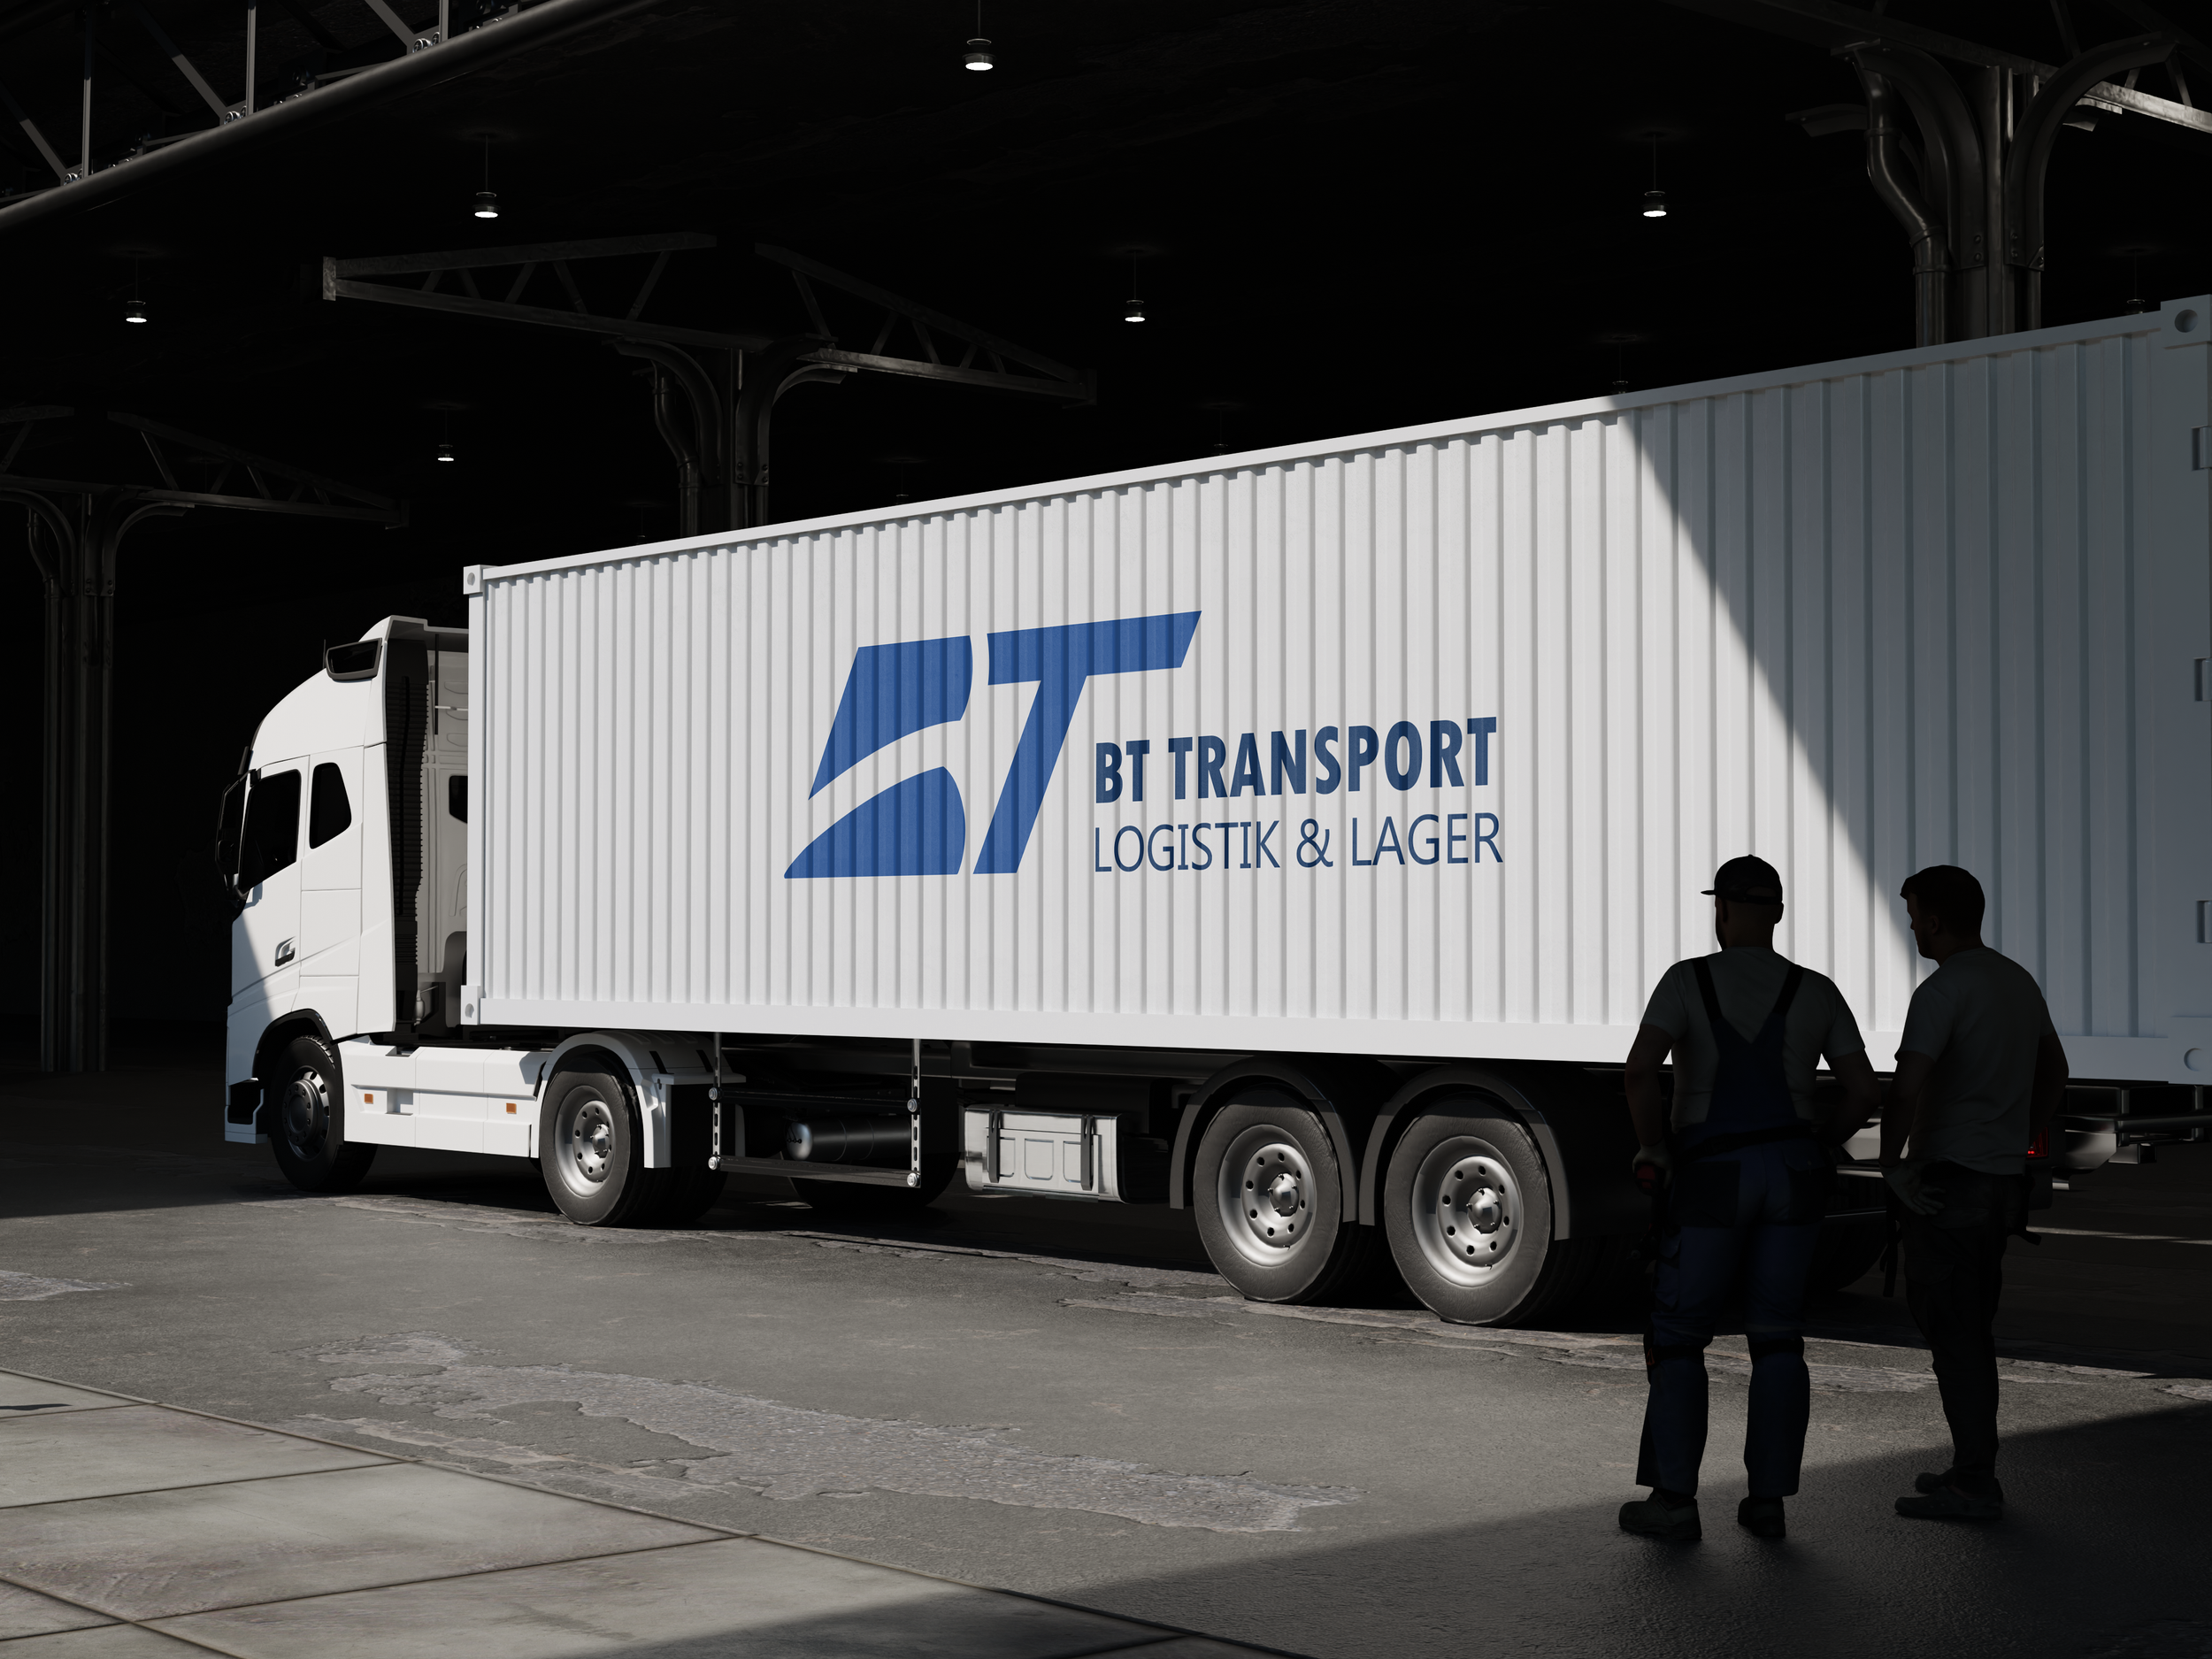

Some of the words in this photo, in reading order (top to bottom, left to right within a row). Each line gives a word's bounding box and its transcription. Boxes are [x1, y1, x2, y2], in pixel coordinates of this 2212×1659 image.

[784, 611, 1202, 879] BT
[1095, 740, 1150, 803] BT
[1168, 716, 1497, 801] TRANSPORT
[1094, 819, 1281, 872] LOGISTIK
[1295, 818, 1334, 869] &
[1352, 812, 1504, 866] LAGER
